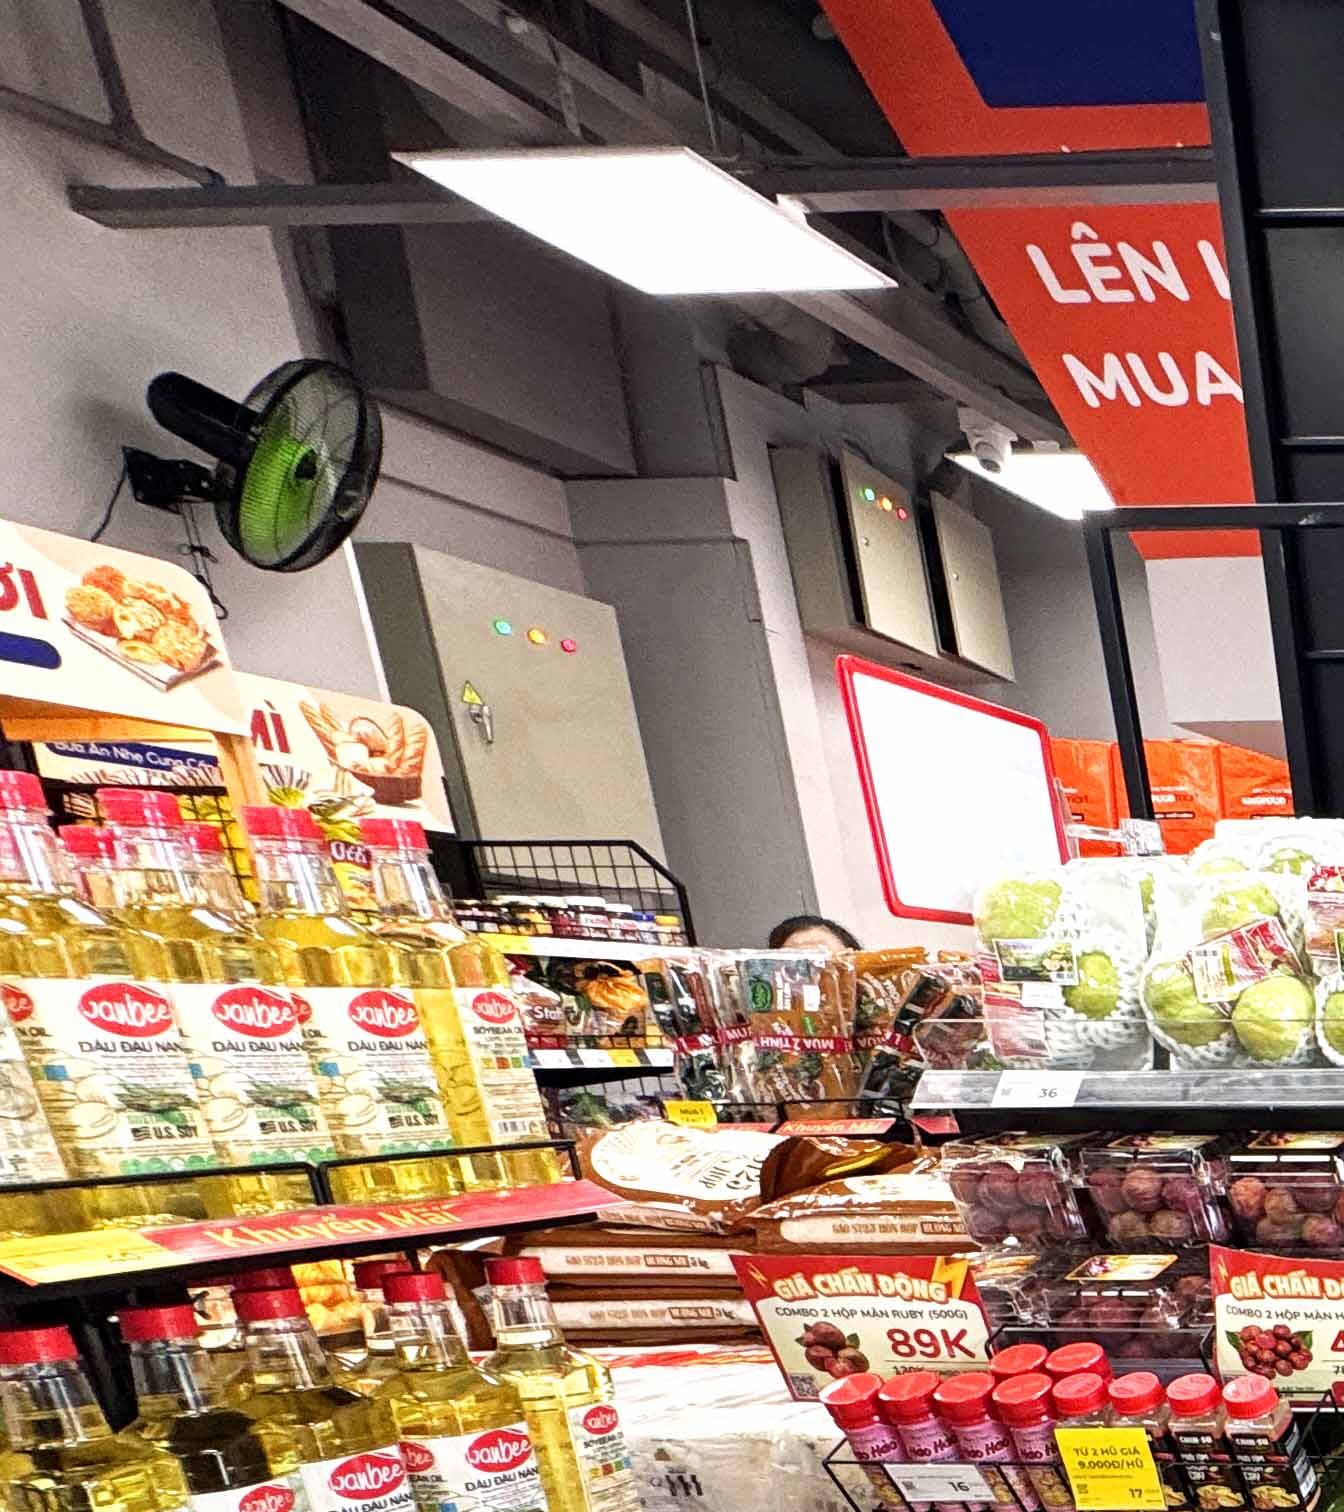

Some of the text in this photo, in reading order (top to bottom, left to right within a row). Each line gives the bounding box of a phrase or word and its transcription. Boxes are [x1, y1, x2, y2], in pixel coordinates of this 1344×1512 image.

[1026, 221, 1191, 303] LÊN
[1062, 351, 1244, 408] MUA
[1038, 1086, 1058, 1098] 36
[207, 1200, 468, 1251] Khuyến Mãi
[886, 1328, 976, 1359] 89K
[949, 1481, 971, 1493] 16
[1128, 1488, 1143, 1499] 17
